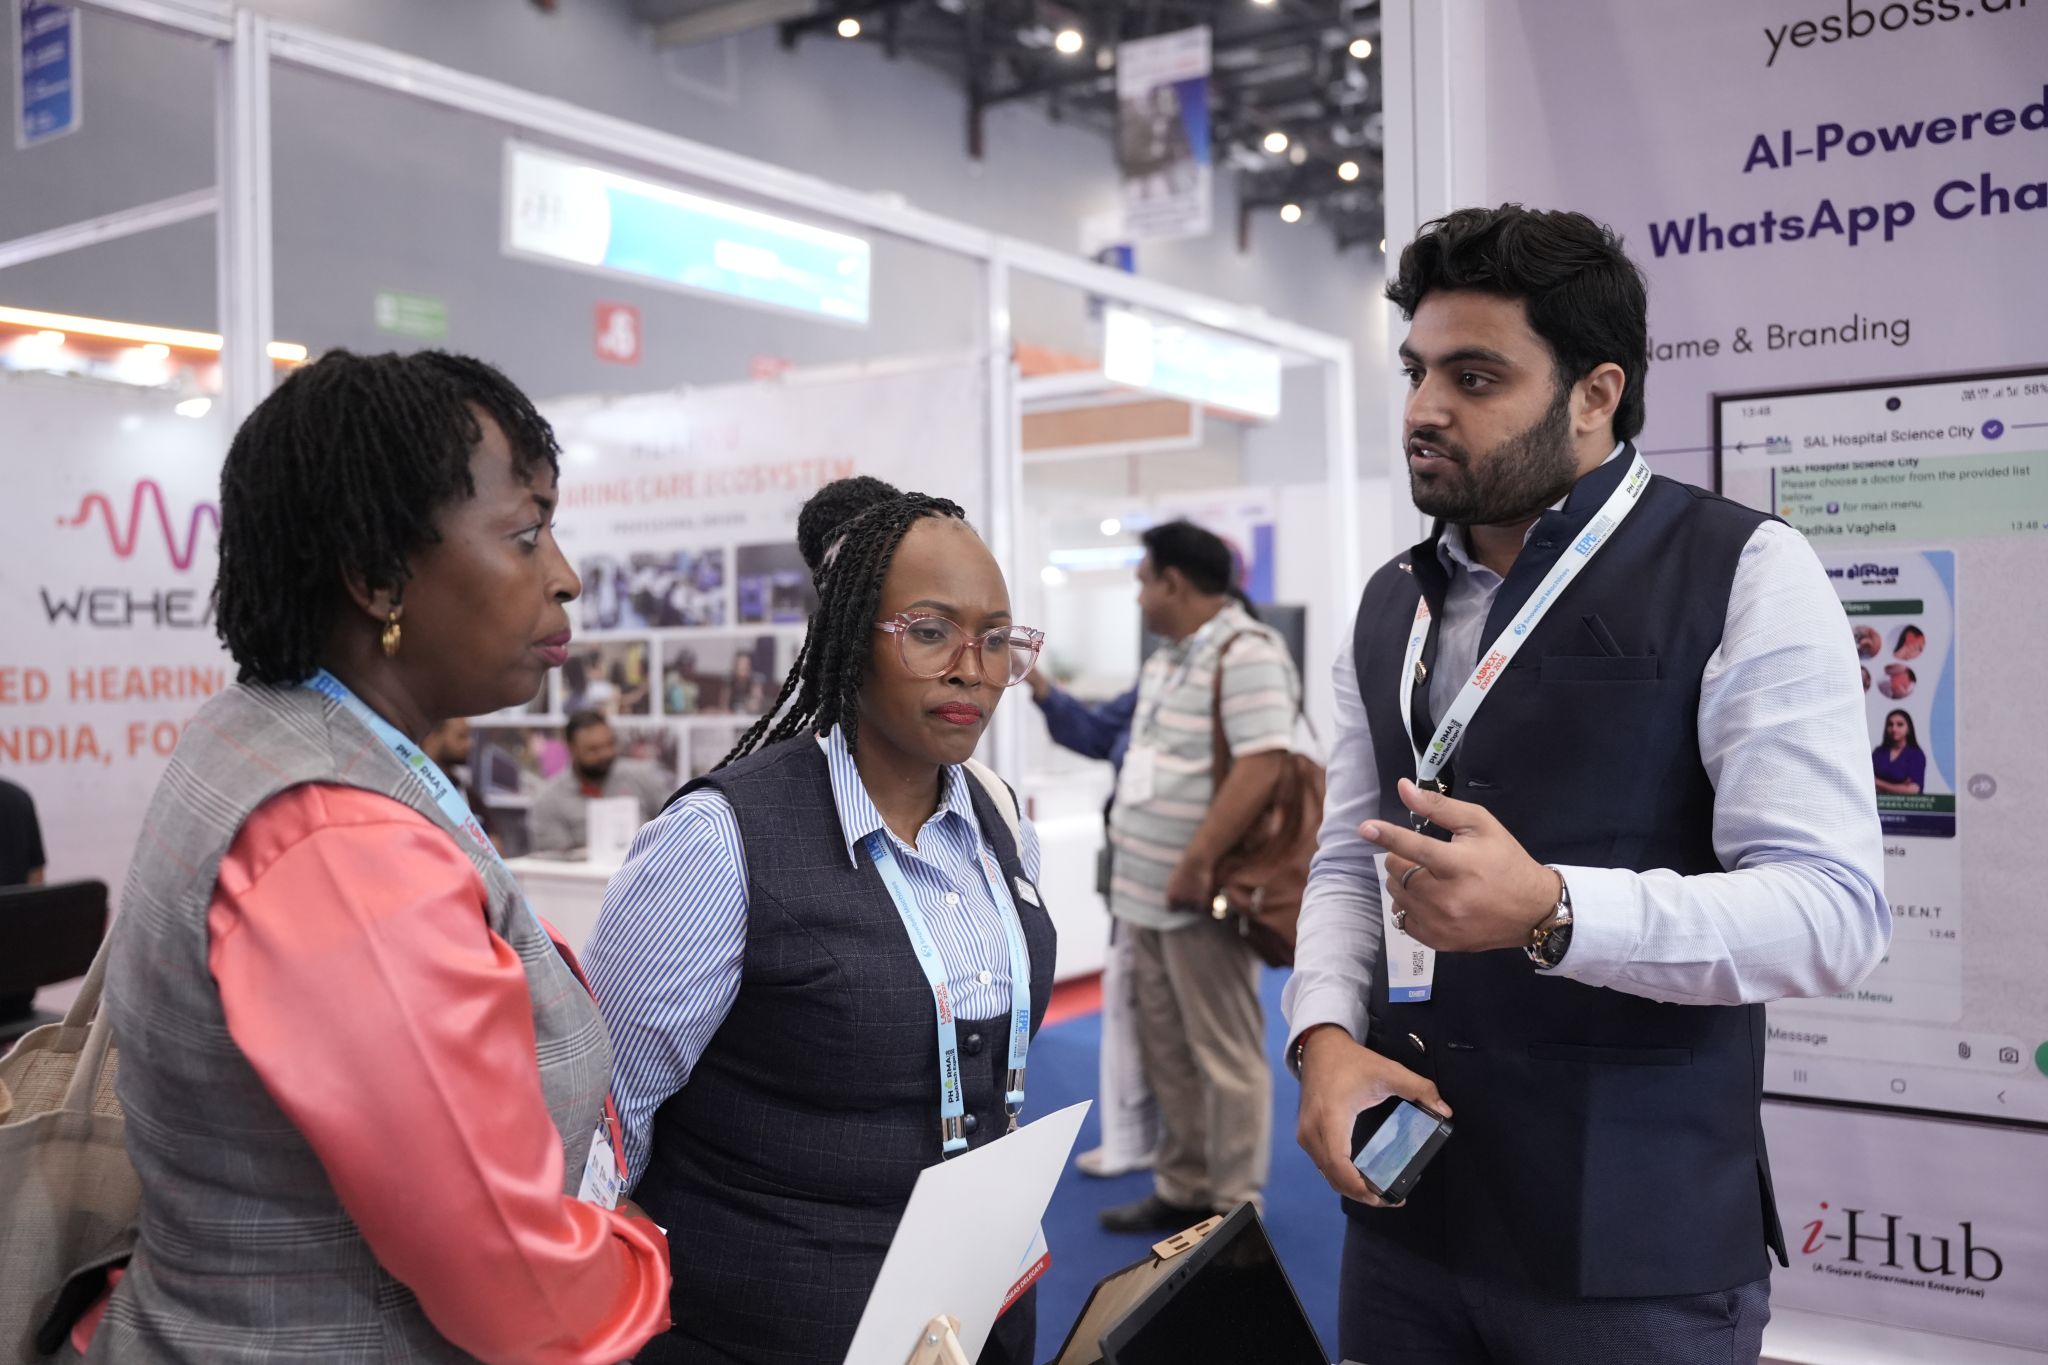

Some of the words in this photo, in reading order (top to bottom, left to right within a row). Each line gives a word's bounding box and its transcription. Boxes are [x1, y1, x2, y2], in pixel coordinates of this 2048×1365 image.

[1763, 0, 2027, 67] yesboss.
[1743, 84, 2048, 174] AI-Powered
[1649, 199, 1916, 258] WhatsApp
[1645, 337, 1720, 362] ame
[1732, 327, 1753, 354] &
[1767, 312, 1911, 347] Branding
[1803, 436, 1829, 448] SAL
[1832, 431, 1888, 447] Hospital
[1891, 428, 1944, 443] Science
[1948, 425, 1976, 440] City
[1781, 478, 1816, 489] Please
[1819, 475, 1858, 486] choose
[1871, 472, 1907, 484] doctor
[1909, 471, 1935, 482] from
[1938, 470, 1956, 480] the
[1959, 466, 2009, 481] provided
[2012, 464, 2031, 476] list
[1805, 461, 1849, 473] Hospital
[1852, 458, 1895, 470] Science
[1898, 456, 1920, 468] City
[1799, 504, 1823, 515] Type
[1843, 502, 1858, 511] for
[1861, 501, 1888, 510] main
[1846, 521, 1896, 535] Vaghela
[1480, 671, 1496, 690] EXPO
[127, 717, 182, 757] FO
[1857, 990, 1893, 1004] Menu
[945, 1001, 953, 1024] EXPO
[1801, 1200, 2004, 1282] i-Hub
[1020, 1260, 1045, 1288] DELEGATE
[1825, 1264, 1863, 1279] Gujarat
[1864, 1269, 1926, 1289] Government
[1927, 1280, 1986, 1299] Enterprise)
